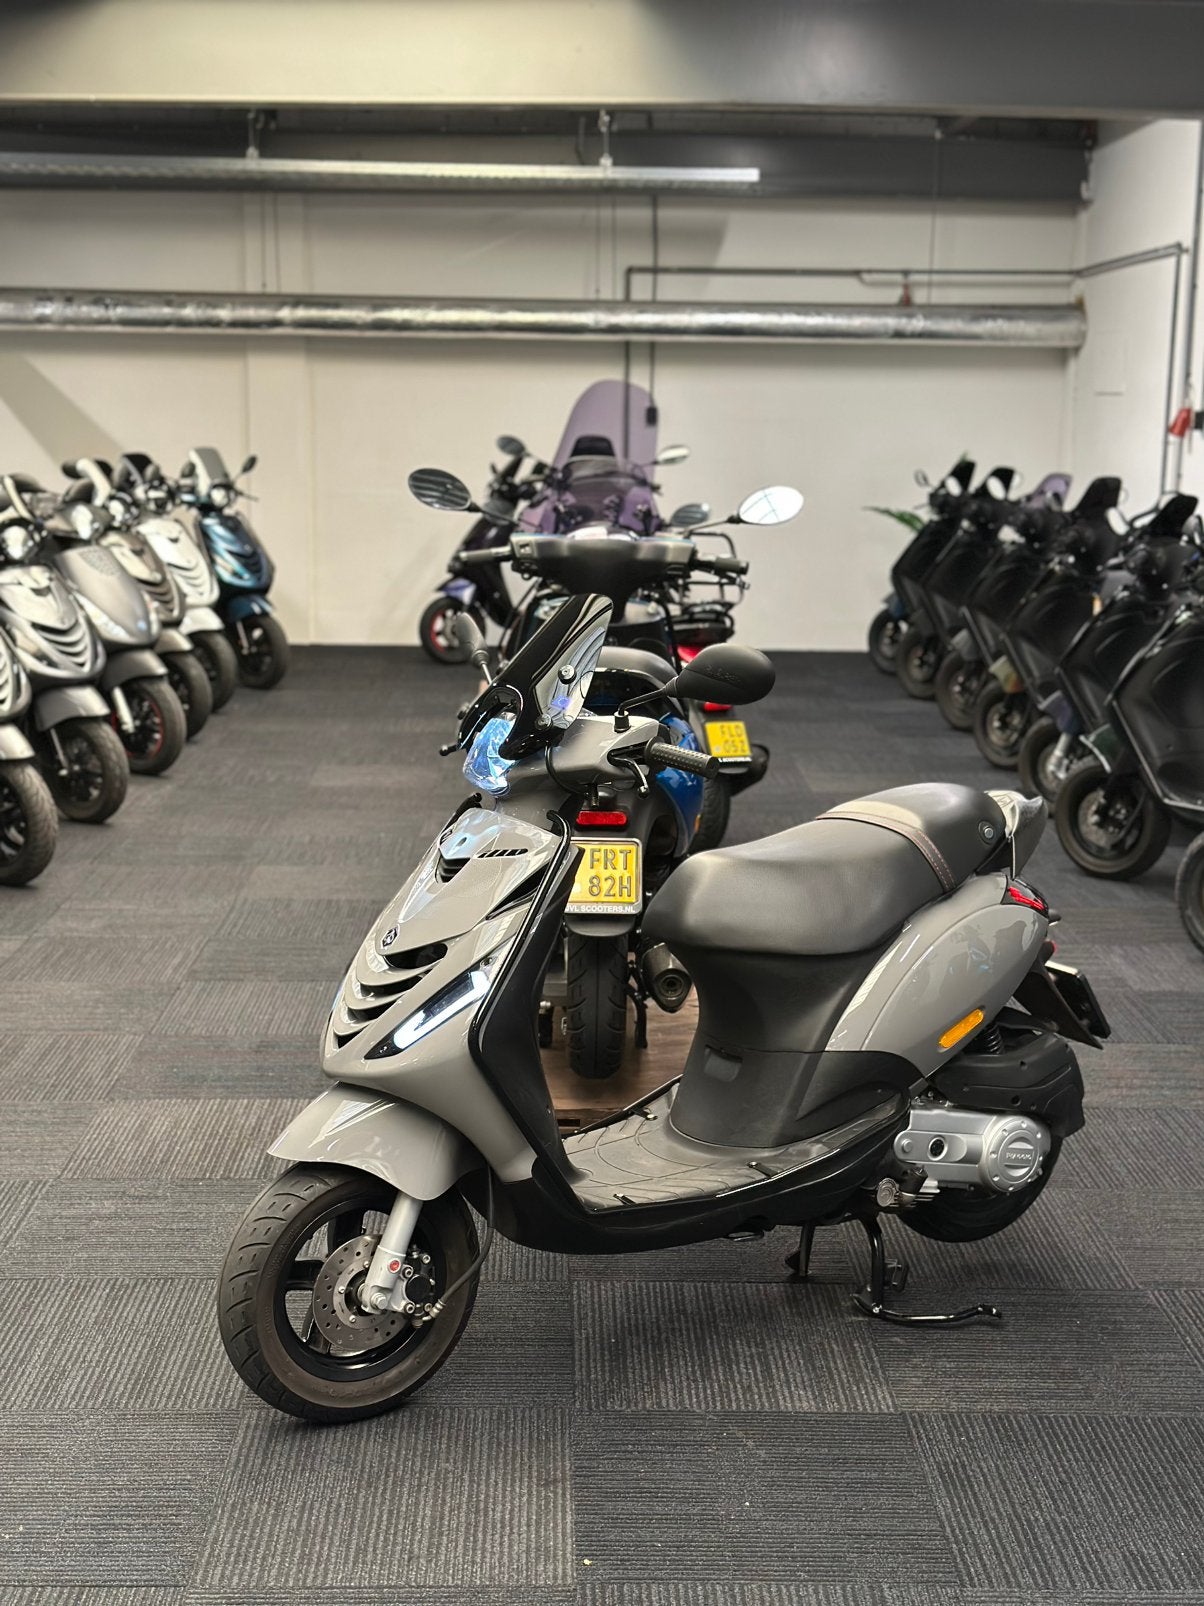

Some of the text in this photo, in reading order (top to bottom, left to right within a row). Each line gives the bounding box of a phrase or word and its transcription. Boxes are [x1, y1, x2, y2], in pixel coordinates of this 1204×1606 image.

[589, 848, 632, 870] FRT
[588, 875, 632, 897] 82H
[580, 905, 636, 913] SCOOTERS.NL
